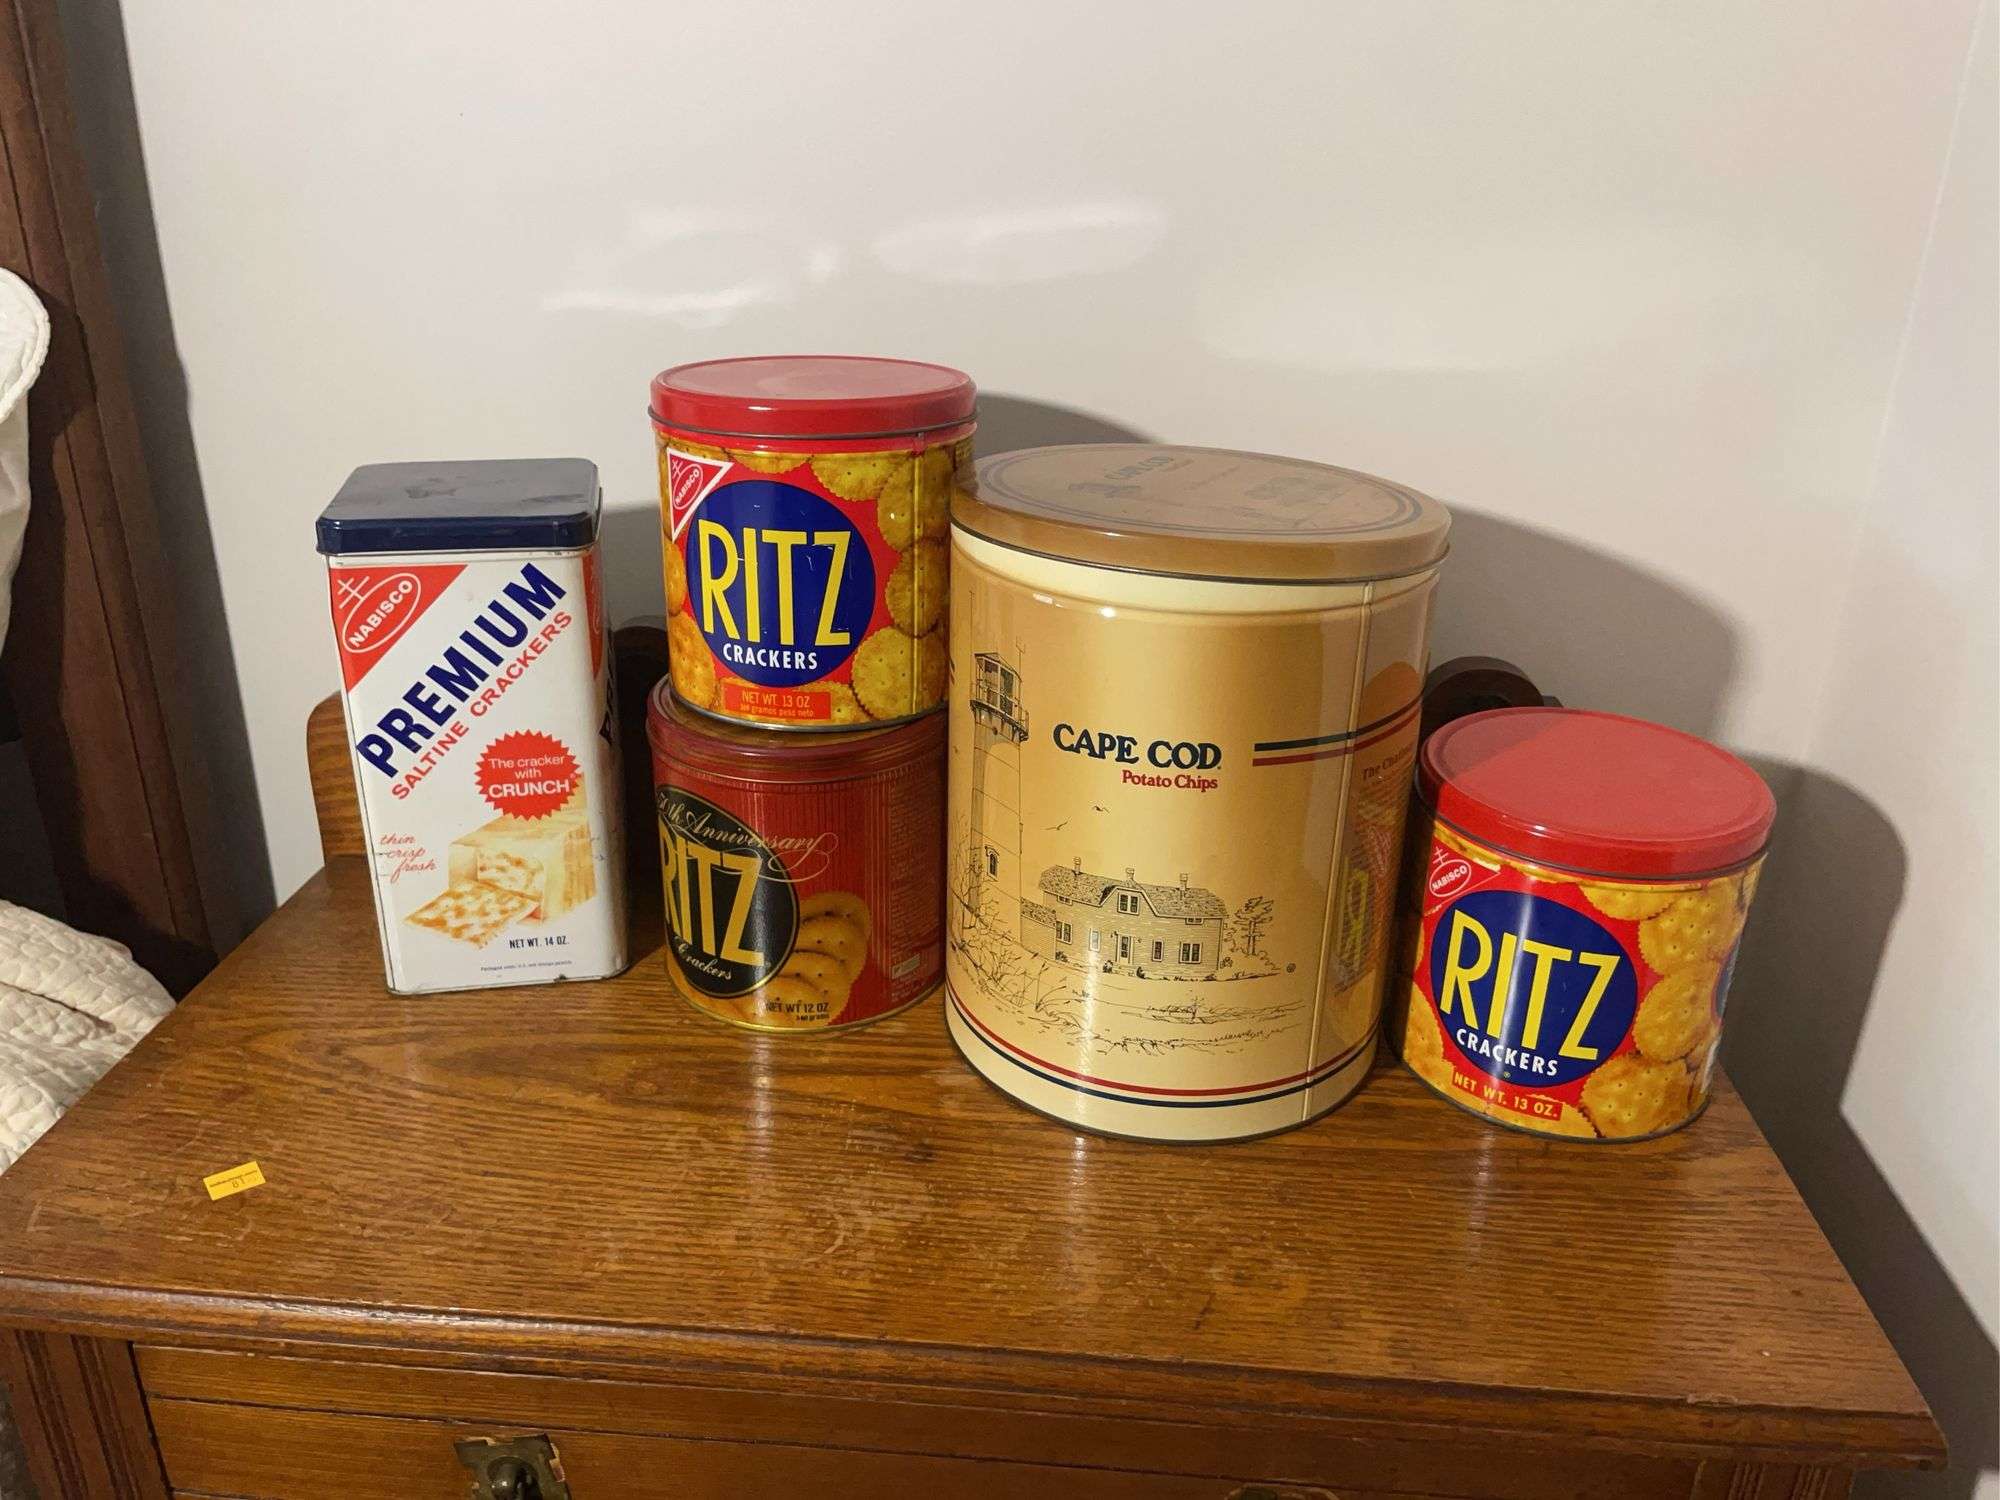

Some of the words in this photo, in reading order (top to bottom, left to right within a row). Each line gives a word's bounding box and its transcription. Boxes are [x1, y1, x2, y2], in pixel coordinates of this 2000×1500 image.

[675, 469, 700, 503] NABISCO
[698, 519, 851, 646] RITZ
[350, 580, 413, 647] NABISCO
[356, 562, 567, 778] PREMIUM
[723, 643, 818, 670] CRACKERS
[392, 721, 470, 800] SALTINE
[470, 611, 573, 717] CRACKERS
[742, 690, 760, 704] NET
[782, 695, 794, 708] 13
[796, 696, 811, 708] OZ
[1053, 723, 1140, 764] CAPE
[488, 758, 515, 769] The
[517, 755, 565, 768] cracker
[514, 768, 542, 779] with
[489, 779, 570, 798] CRUNCH
[1122, 769, 1172, 789] Potato
[1174, 774, 1218, 793] Chips
[379, 833, 416, 845] thin
[686, 811, 836, 872] Anniversary
[388, 848, 426, 861] crisp
[390, 859, 437, 884] fresh
[1432, 865, 1468, 890] NABISCO
[659, 813, 764, 966] RITZ
[509, 939, 524, 949] NET
[545, 937, 554, 946] 14
[674, 936, 732, 980] Crackers
[1440, 909, 1620, 1061] RITZ
[765, 1002, 783, 1013] NET
[785, 1003, 801, 1013] WT
[803, 1003, 814, 1013] 12
[816, 1002, 829, 1012] OZ
[1456, 1028, 1558, 1076] CRACKERS
[1454, 1072, 1476, 1092] NET
[1484, 1083, 1507, 1105] WT.
[1514, 1096, 1528, 1111] 13
[1533, 1102, 1558, 1119] OZ.
